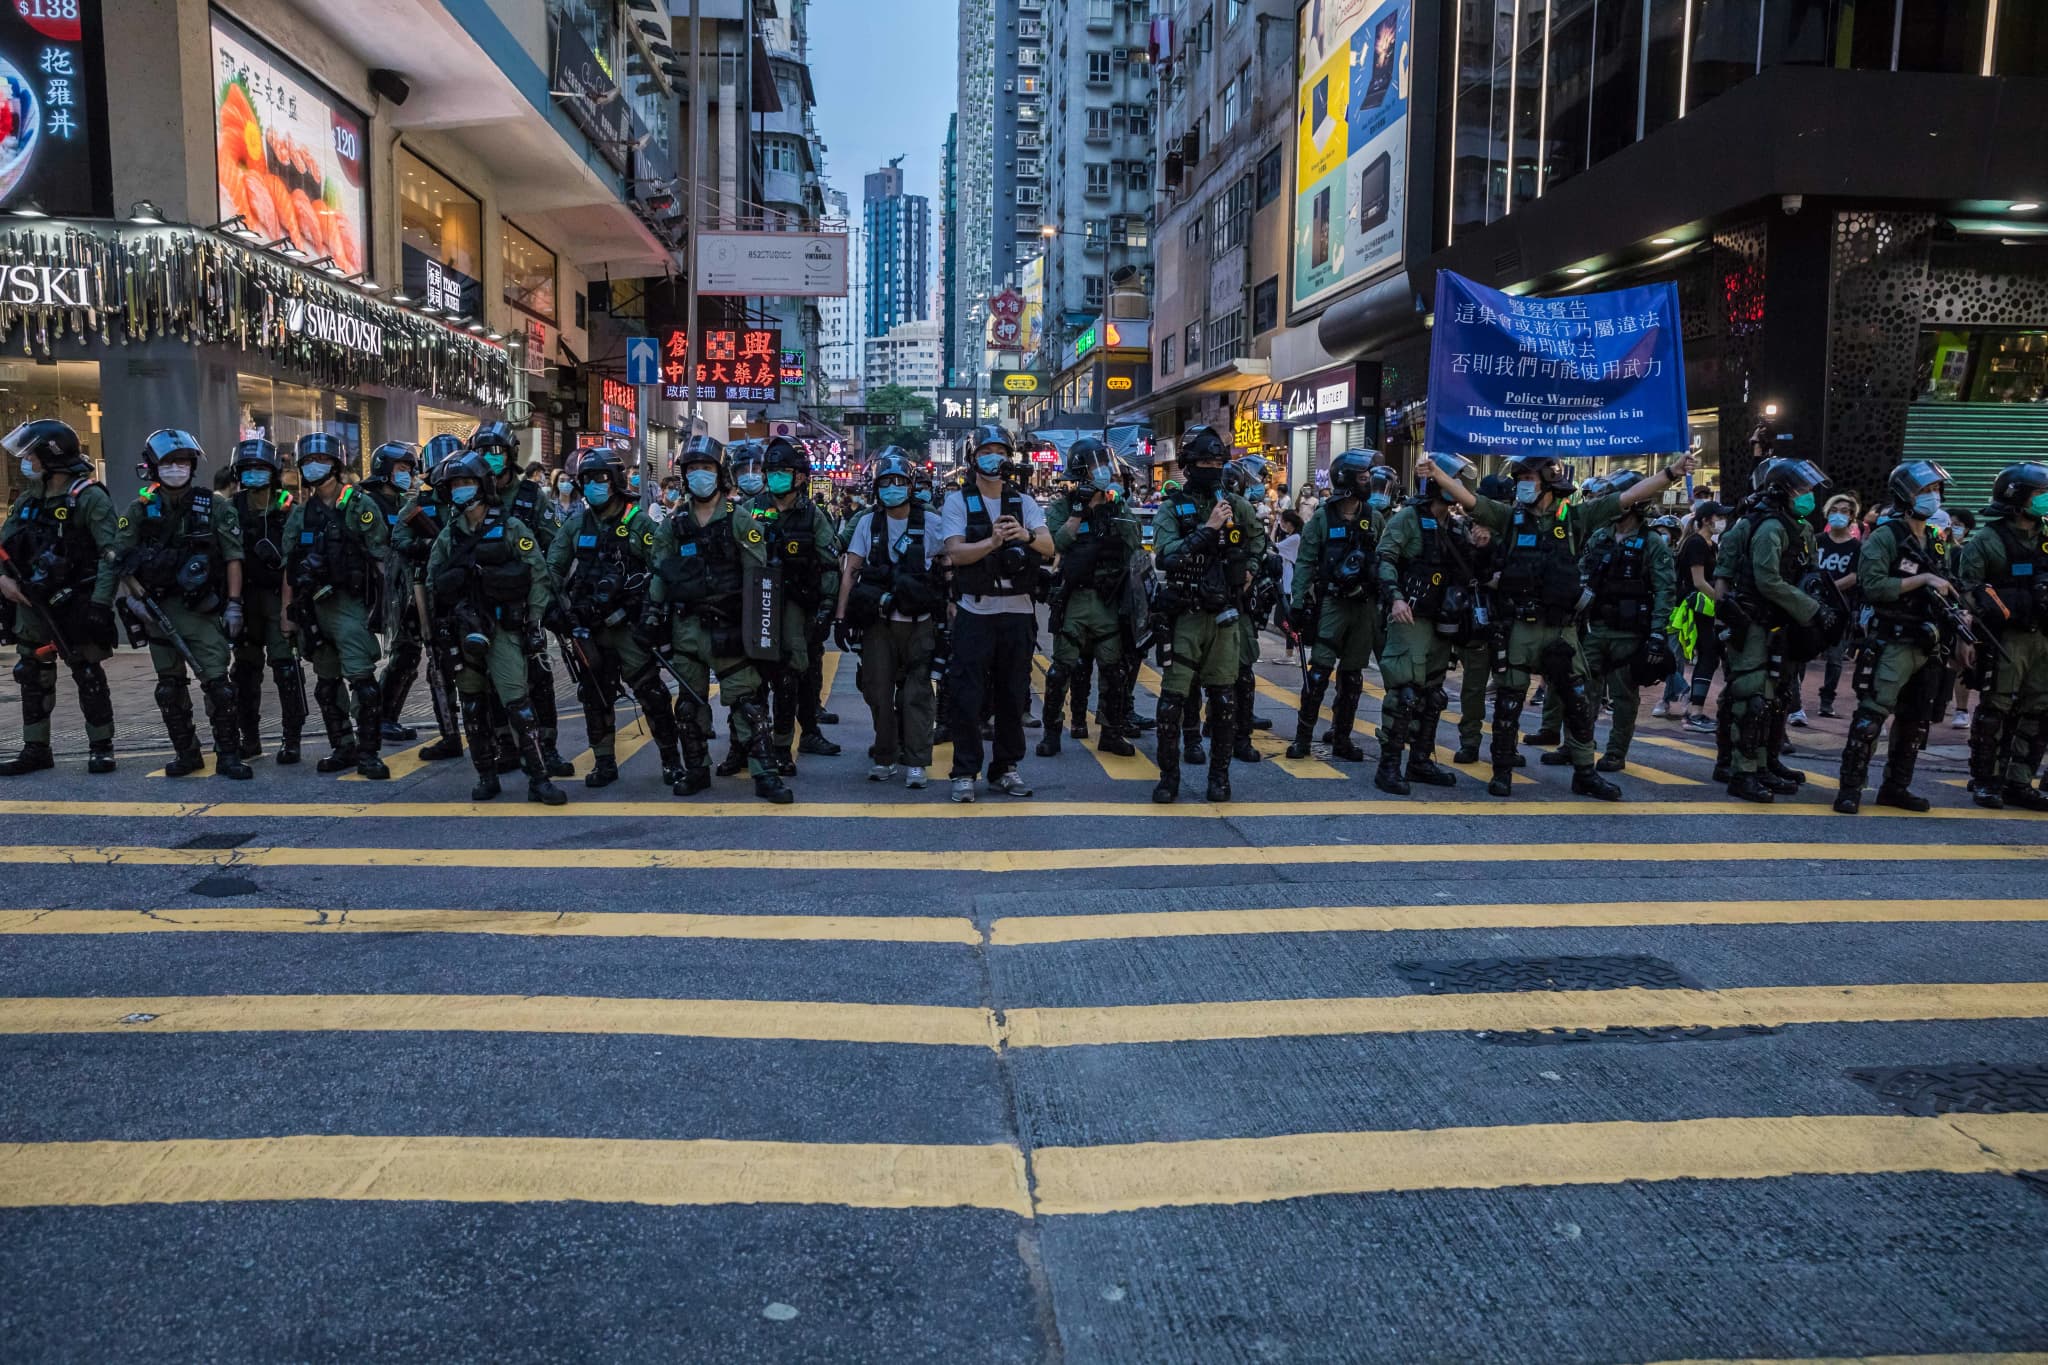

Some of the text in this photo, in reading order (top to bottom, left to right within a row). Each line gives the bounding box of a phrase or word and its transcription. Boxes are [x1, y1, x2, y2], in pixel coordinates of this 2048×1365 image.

[307, 303, 382, 355] SWAROVSKI
[996, 322, 1016, 340] 押
[738, 331, 776, 362] 興
[1519, 335, 1596, 359] 請即散去
[1450, 353, 1662, 381] 否則我們可能使用武力
[1287, 388, 1343, 419] Clarks OUTLET
[1504, 391, 1605, 408] Police Warning:
[1467, 405, 1644, 423] This meeting or procession is in
[1468, 432, 1644, 449] Disperse or we may use force.
[1503, 422, 1607, 435] breach of the law.
[1817, 547, 1851, 573] Lee
[761, 591, 772, 636] POLICE
